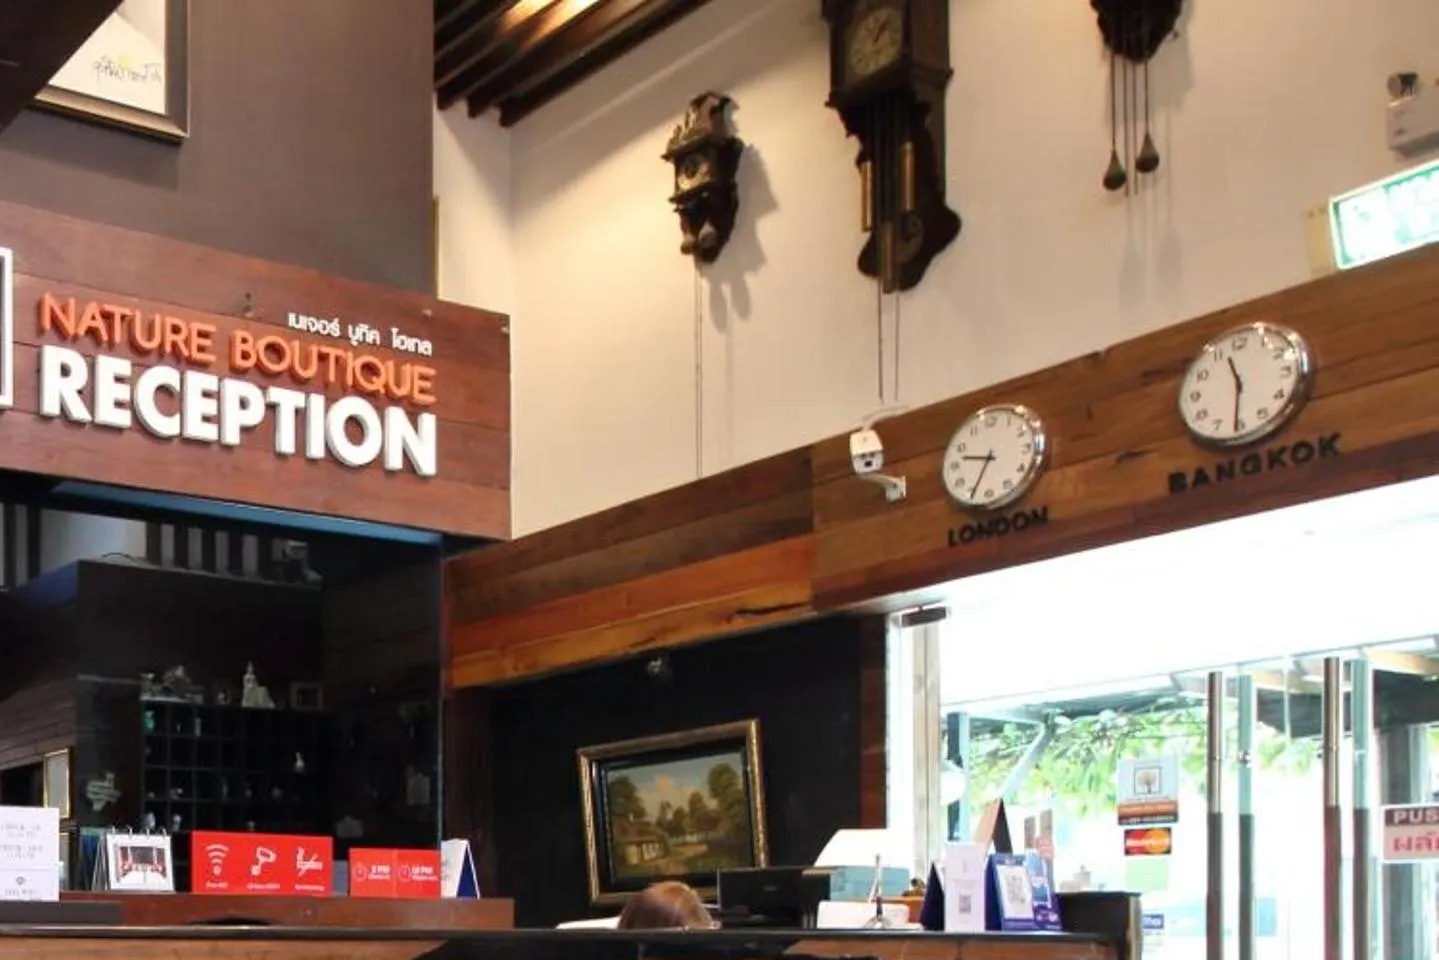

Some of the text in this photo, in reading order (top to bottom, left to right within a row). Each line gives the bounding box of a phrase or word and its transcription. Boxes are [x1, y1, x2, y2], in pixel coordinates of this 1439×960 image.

[37, 292, 437, 405] NATURE BOUTIQUE
[39, 344, 437, 477] RECEPTION
[1167, 432, 1341, 493] BANGKOK
[948, 505, 1048, 547] LONDON
[1393, 831, 1439, 852] ผลั
